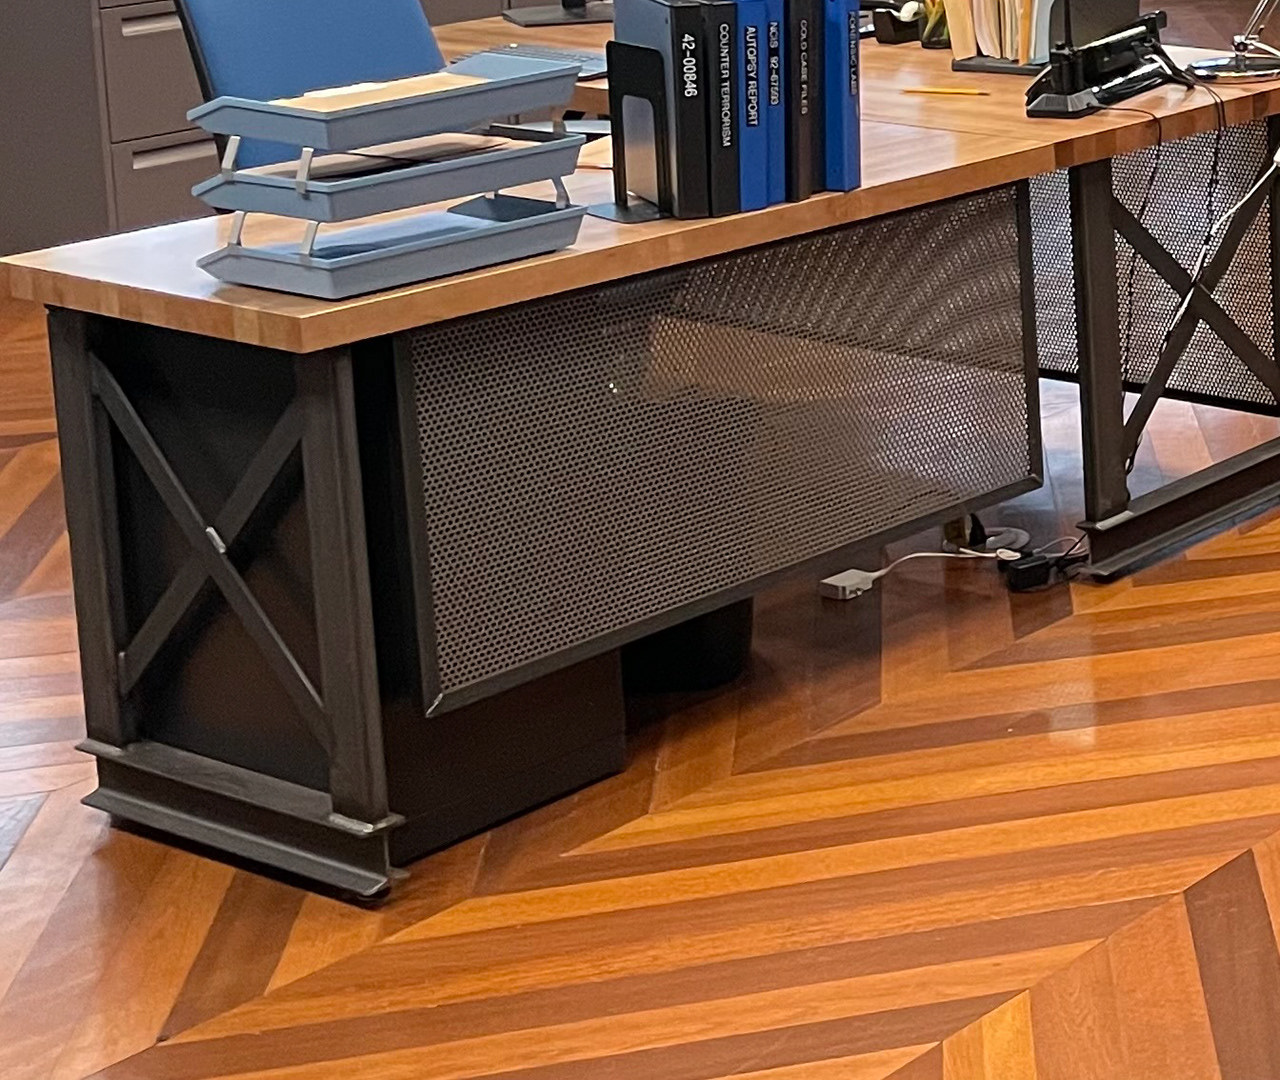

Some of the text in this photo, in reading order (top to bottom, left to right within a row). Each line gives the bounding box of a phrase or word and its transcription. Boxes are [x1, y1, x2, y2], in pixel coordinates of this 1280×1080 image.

[682, 33, 698, 97] 42-00846
[769, 21, 779, 48] NCIS
[719, 23, 731, 147] COUNTER TERRORISM
[746, 26, 758, 125] AUTOPSY REPORT
